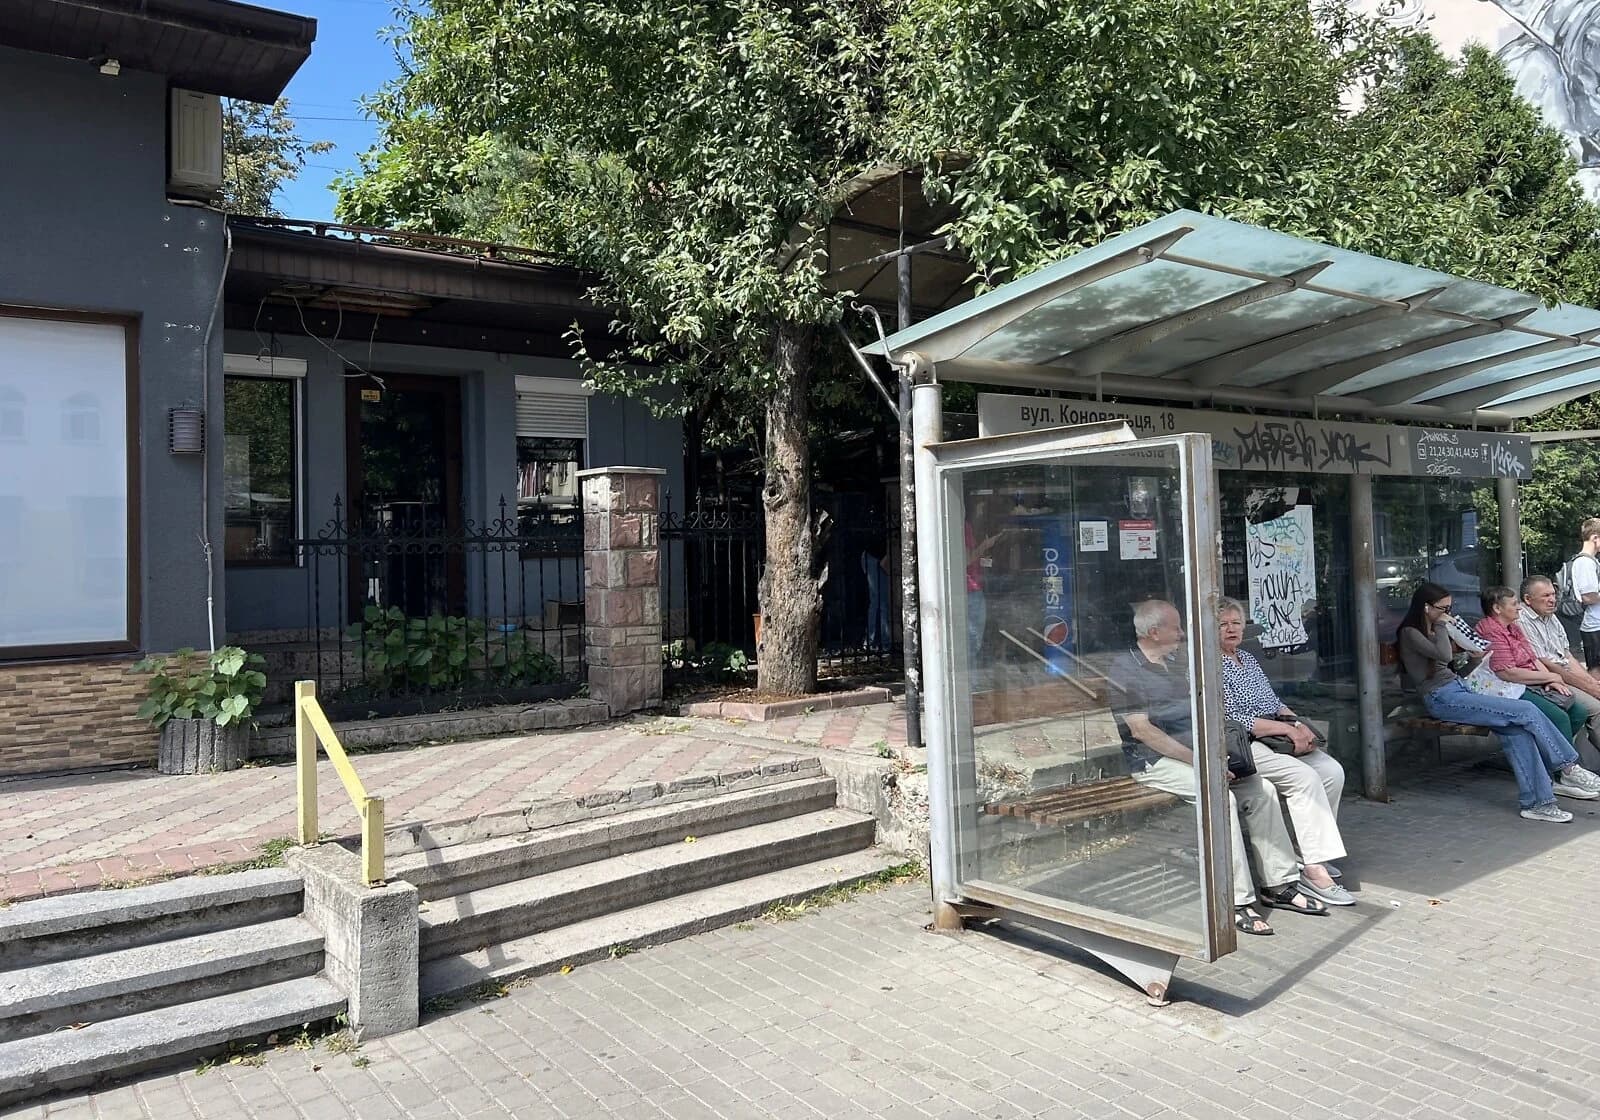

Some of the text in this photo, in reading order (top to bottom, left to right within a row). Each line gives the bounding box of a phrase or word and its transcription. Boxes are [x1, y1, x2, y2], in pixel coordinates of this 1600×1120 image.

[1020, 406, 1054, 426] вул.
[1160, 411, 1175, 430] 18
[1042, 548, 1064, 610] pesi
